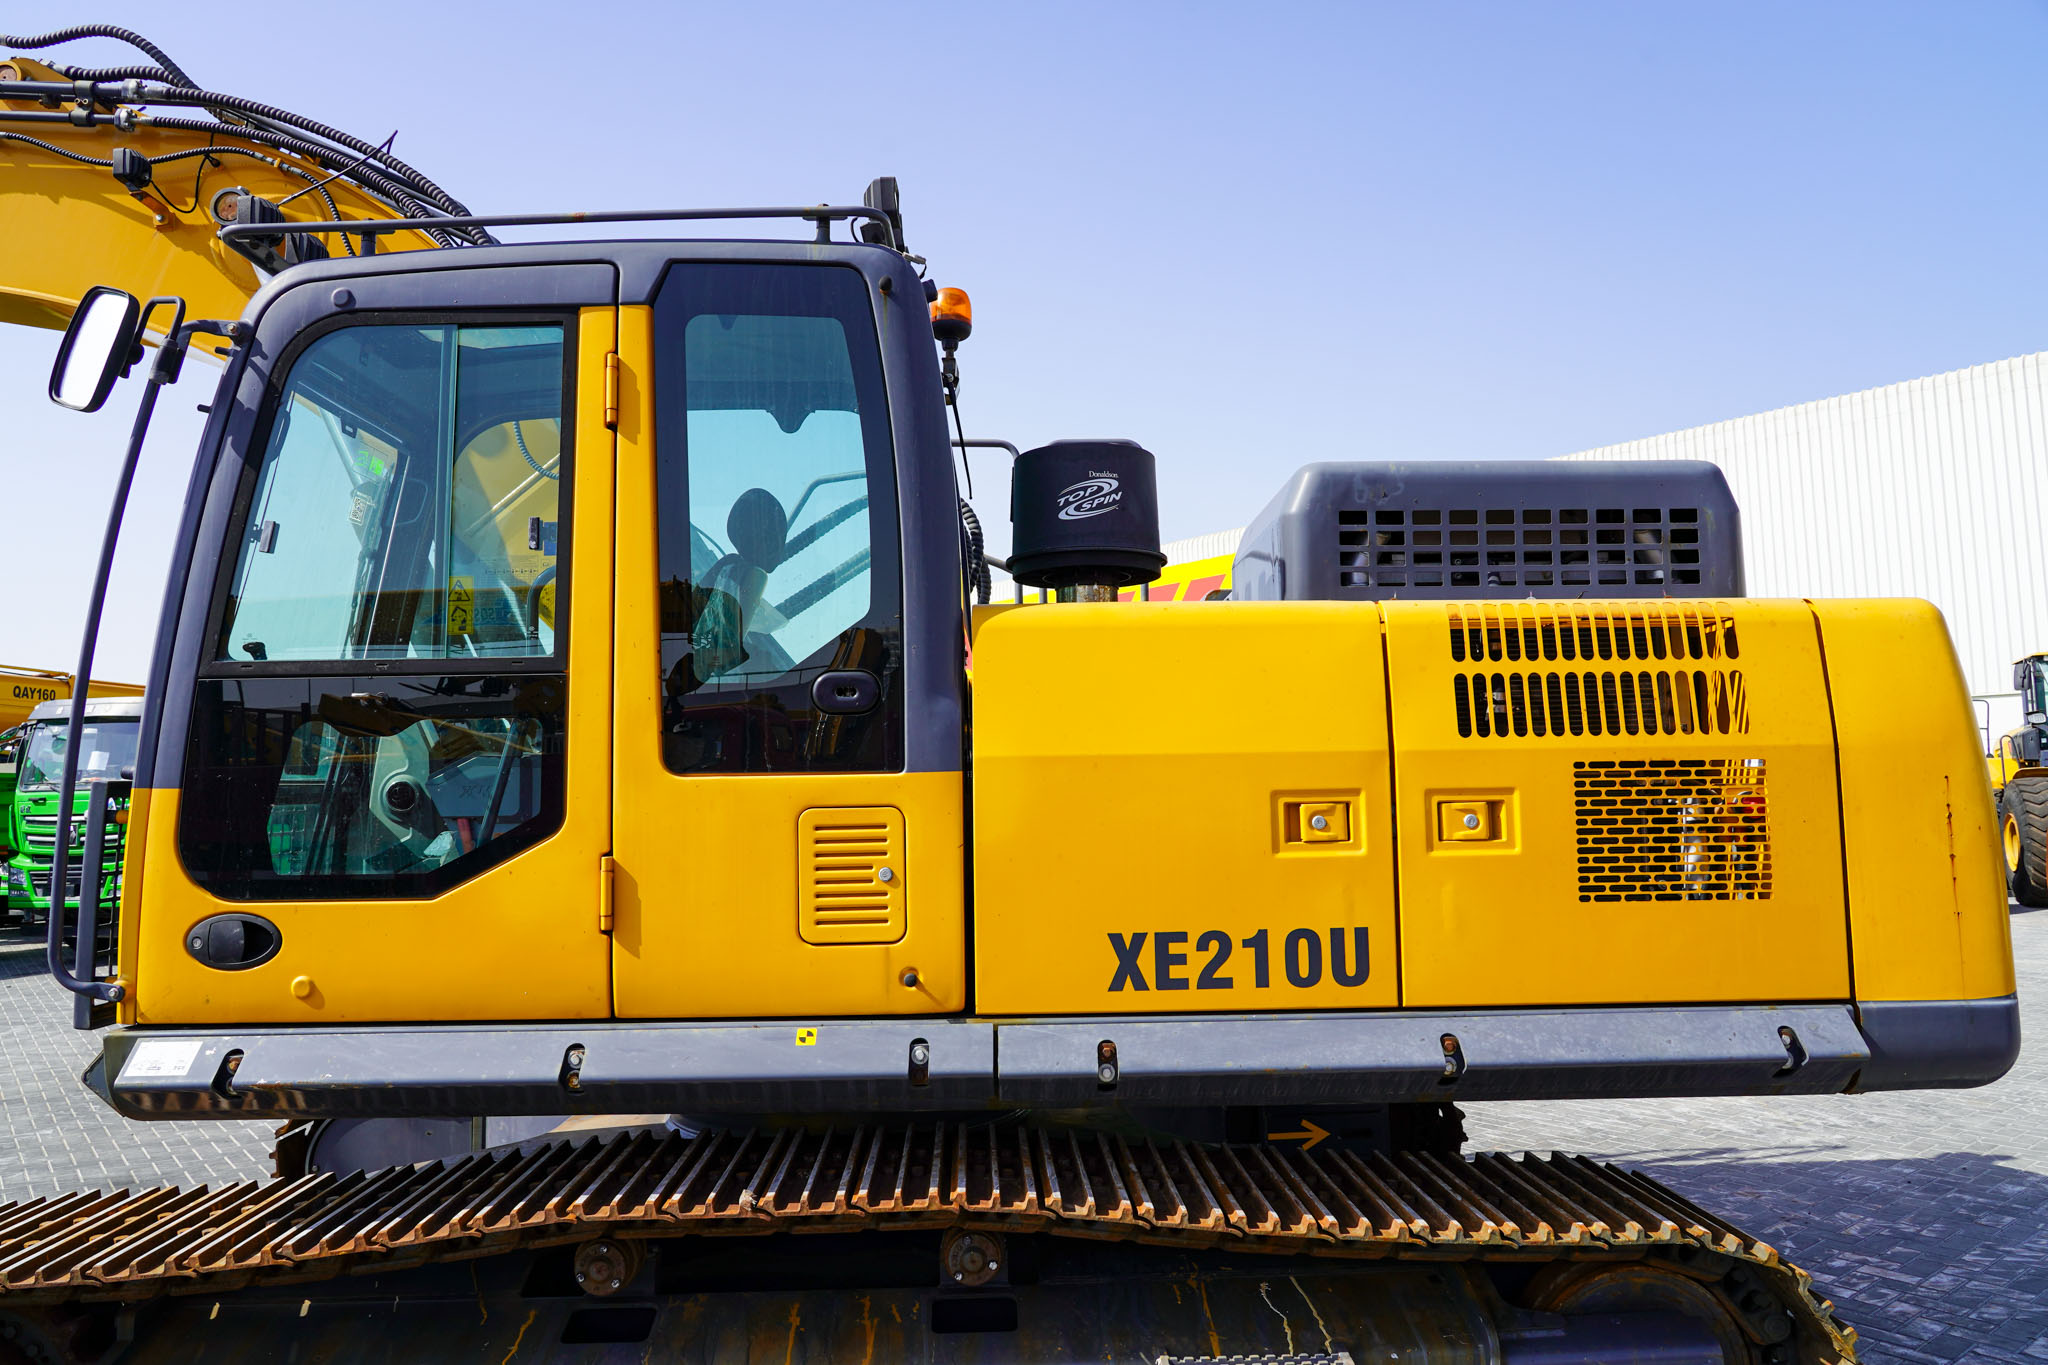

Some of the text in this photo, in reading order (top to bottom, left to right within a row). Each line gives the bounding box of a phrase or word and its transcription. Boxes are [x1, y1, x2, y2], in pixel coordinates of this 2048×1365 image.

[1057, 486, 1098, 506] TOP
[1080, 491, 1123, 511] SPIN
[13, 685, 56, 701] QAY160
[1107, 927, 1370, 992] XE210U
